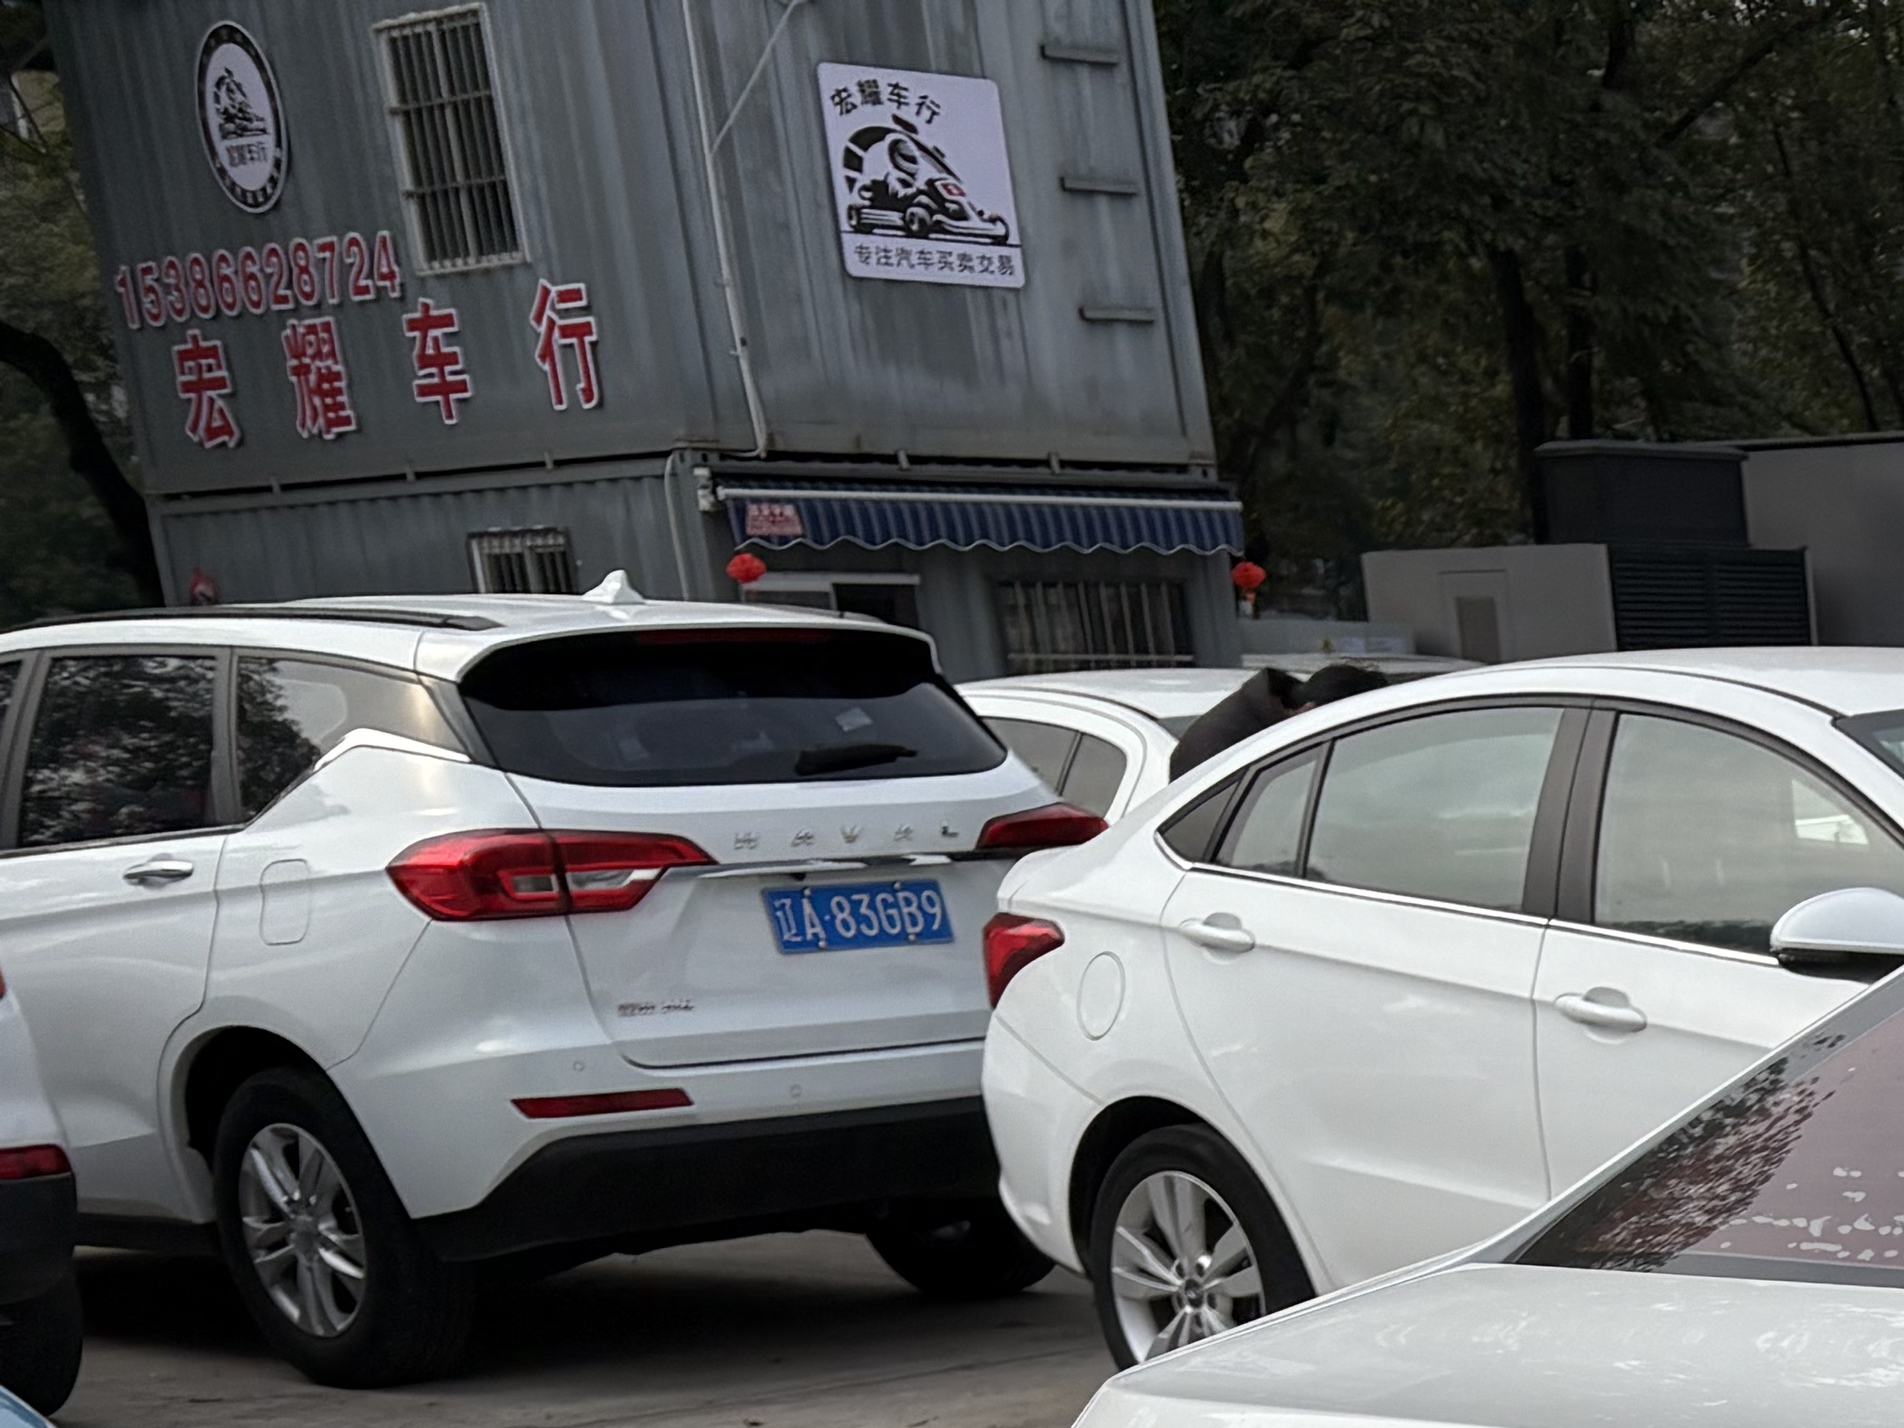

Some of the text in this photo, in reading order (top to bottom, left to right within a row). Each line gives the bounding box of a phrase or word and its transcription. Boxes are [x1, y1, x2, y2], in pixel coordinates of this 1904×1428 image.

[830, 79, 941, 124] 宏耀车行
[115, 231, 401, 329] 15386628724
[855, 244, 1016, 277] 专注汽车买卖交易
[172, 279, 599, 449] 宏耀车行
